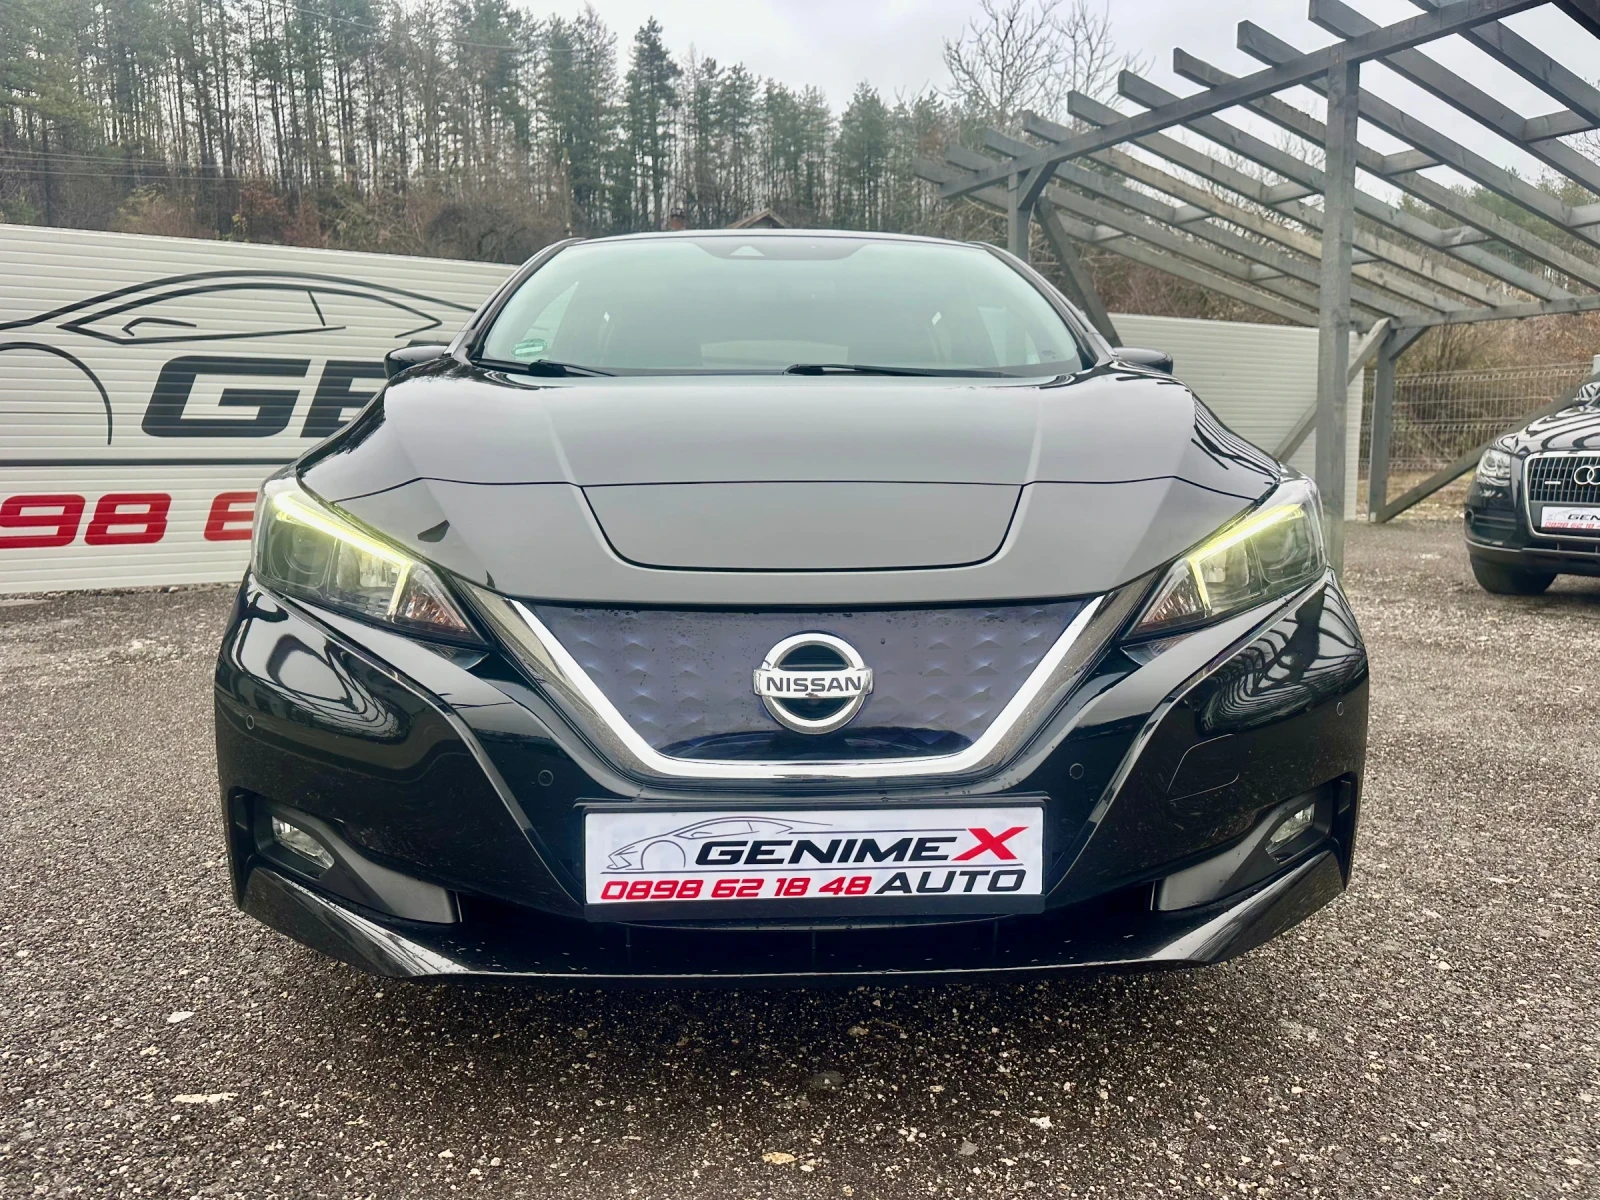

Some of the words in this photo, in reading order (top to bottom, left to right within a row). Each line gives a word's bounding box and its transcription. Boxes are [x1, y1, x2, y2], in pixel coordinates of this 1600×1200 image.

[766, 676, 861, 692] NISSAN
[695, 826, 1029, 865] GENIMEX
[600, 879, 704, 900] 0898
[711, 878, 764, 899] 62
[774, 877, 811, 897] 18
[818, 876, 872, 896] 48
[874, 869, 1027, 895] AUTO
